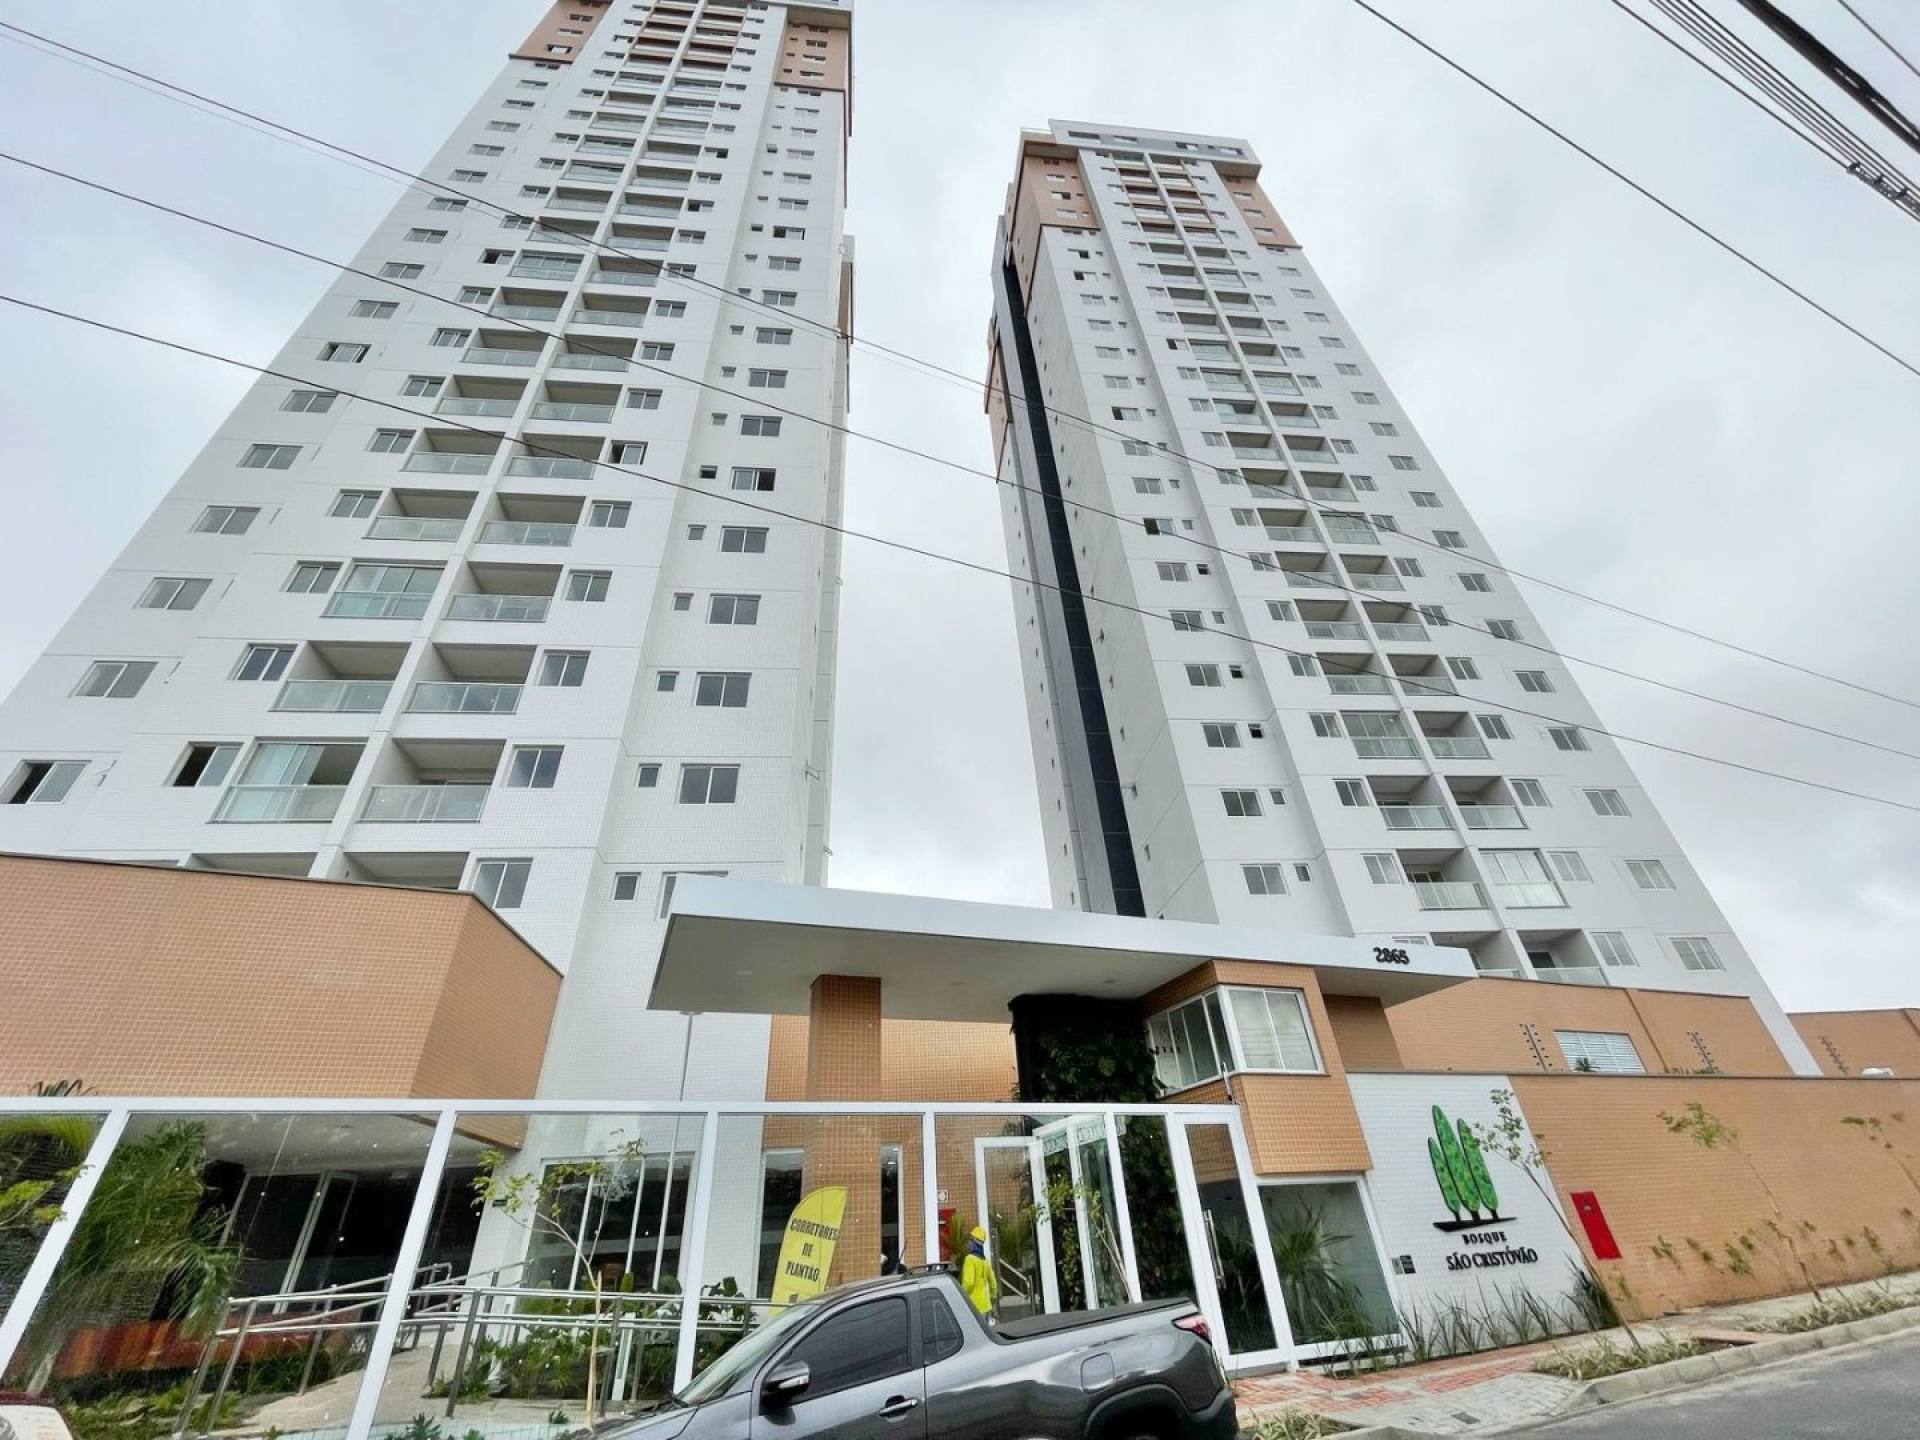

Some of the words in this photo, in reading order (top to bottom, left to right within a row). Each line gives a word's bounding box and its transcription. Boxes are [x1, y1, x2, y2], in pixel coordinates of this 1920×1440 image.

[1373, 946, 1410, 965] 2865
[790, 1219, 840, 1241] CORRETORES
[1461, 1231, 1508, 1245] BOSQUE
[801, 1242, 814, 1257] DE
[1446, 1251, 1472, 1270] SÃO
[1472, 1245, 1538, 1268] CRISTÓVÃO
